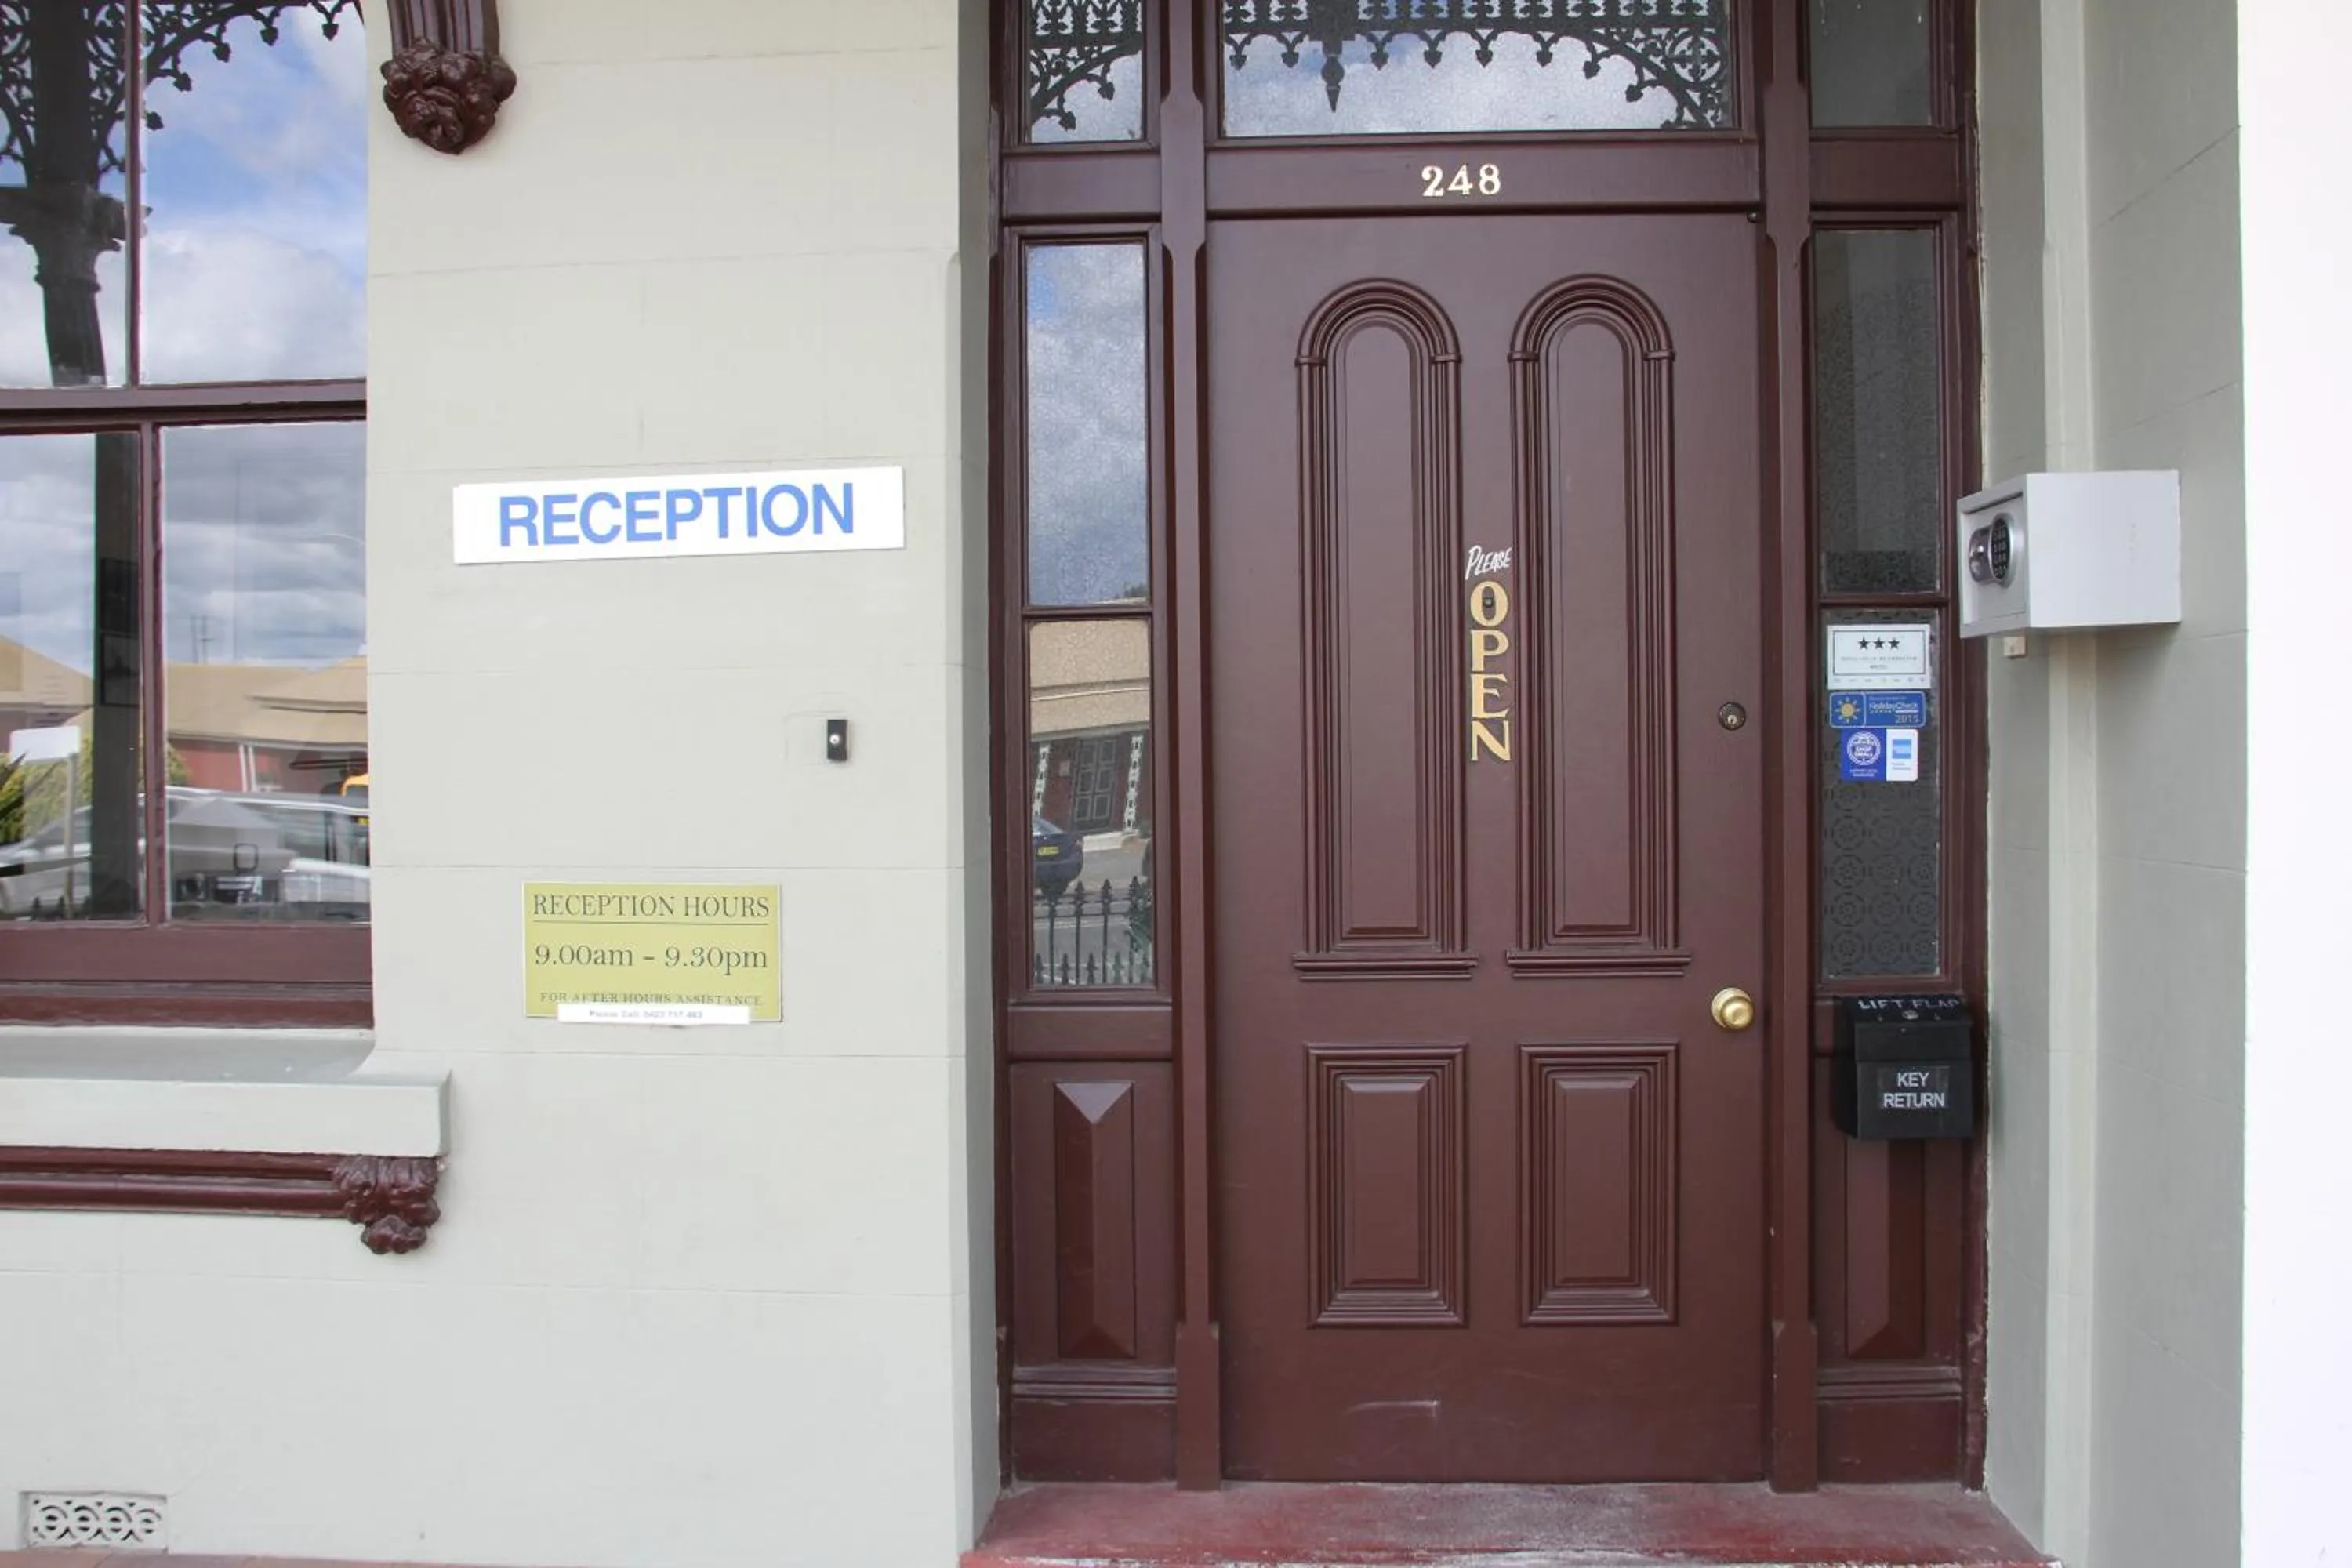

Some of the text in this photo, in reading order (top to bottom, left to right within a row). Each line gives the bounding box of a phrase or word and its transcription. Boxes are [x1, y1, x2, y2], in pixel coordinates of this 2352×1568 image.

[1421, 163, 1501, 197] 248
[499, 482, 854, 547] RECEPTION
[1470, 580, 1512, 762] OPEN
[532, 893, 770, 918] RECEPTION HOURS
[535, 944, 633, 967] 9.00am
[664, 946, 768, 975] 9.30pm
[540, 992, 763, 1006] FOR AFTER HOURS ASSISTANCE
[1857, 998, 1960, 1010] LIFT FLAP
[1896, 1072, 1929, 1087] KEY
[1883, 1092, 1945, 1108] RETURN
